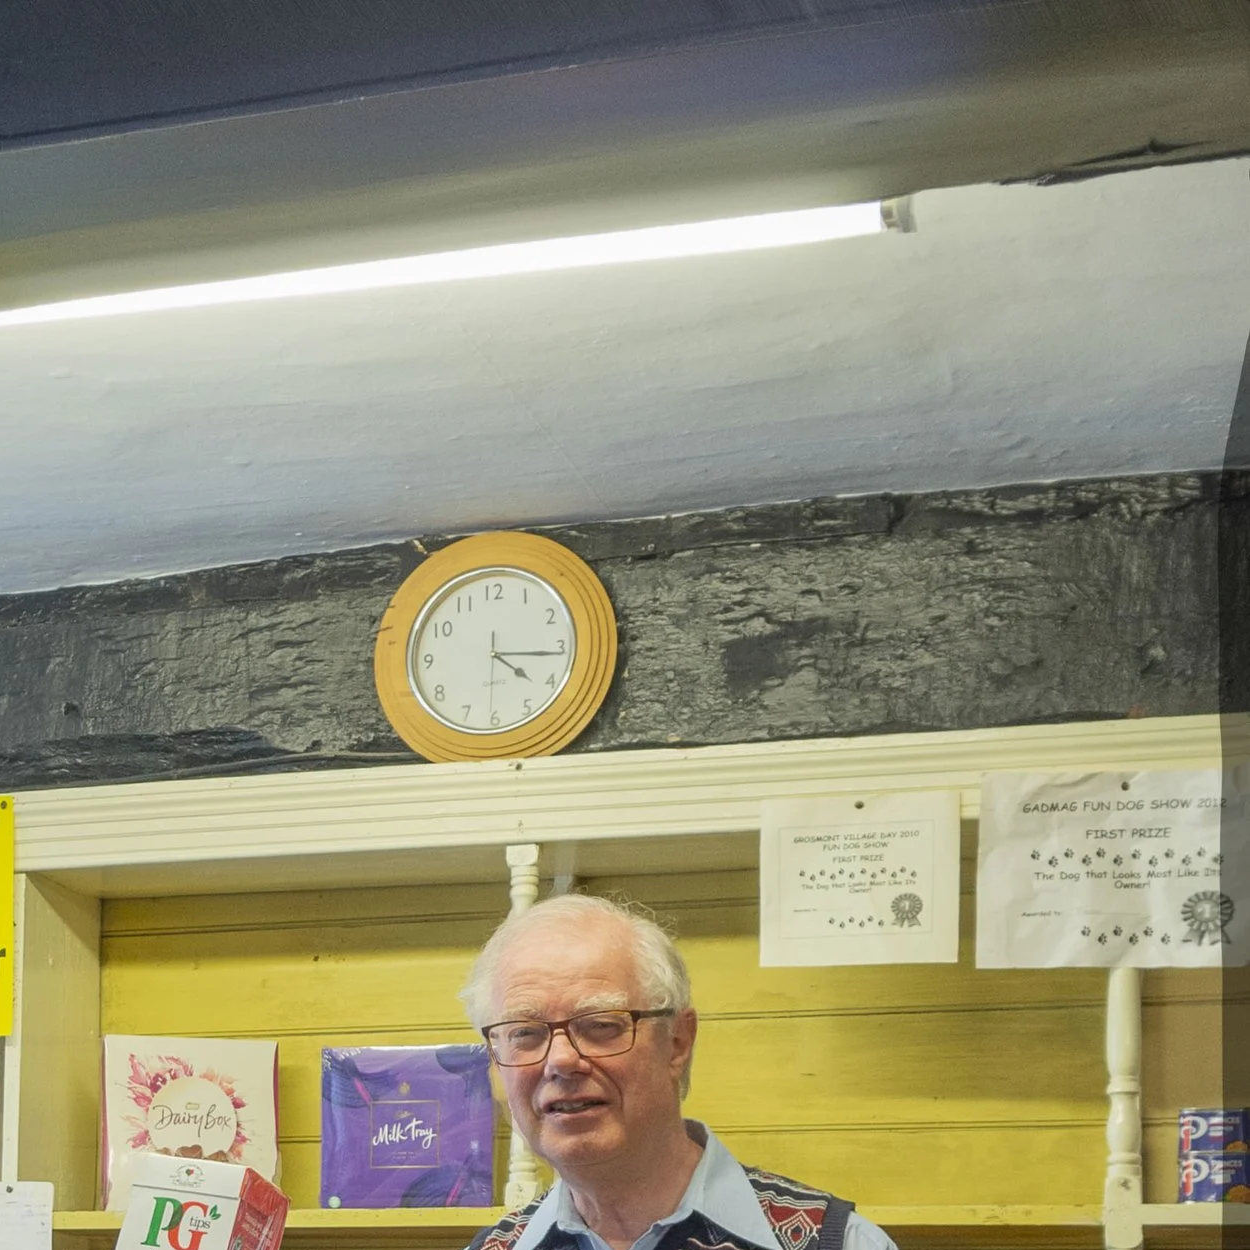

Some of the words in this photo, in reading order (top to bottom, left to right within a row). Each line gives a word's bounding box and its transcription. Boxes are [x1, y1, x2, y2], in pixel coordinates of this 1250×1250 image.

[485, 583, 503, 601] 12
[457, 595, 472, 613] 11
[545, 608, 556, 624] 2
[434, 621, 453, 638] 10
[556, 640, 566, 654] 3
[423, 654, 434, 669] 9
[545, 673, 555, 689] 4
[434, 685, 445, 702] 8
[462, 705, 471, 721] 7
[521, 699, 532, 716] 5
[490, 710, 500, 726] 6
[1022, 800, 1078, 814] GADMAG
[1083, 800, 1111, 812] FUN
[1116, 799, 1144, 811] DOG
[1149, 798, 1192, 809] SHOW
[843, 831, 876, 841] VILLAGE
[880, 831, 898, 839] DAY
[1085, 828, 1126, 839] FIRST
[1131, 827, 1171, 839] PRIZE
[1034, 872, 1054, 880] The
[1060, 871, 1081, 882] Dog
[1086, 870, 1108, 879] that
[1112, 870, 1141, 879] Looks
[1147, 869, 1172, 879] Most
[1177, 868, 1200, 878] Like
[152, 1104, 204, 1138] Dairy
[204, 1103, 233, 1132] Box
[372, 1122, 408, 1146] Milk
[404, 1117, 437, 1150] Tray
[189, 1215, 212, 1232] tips
